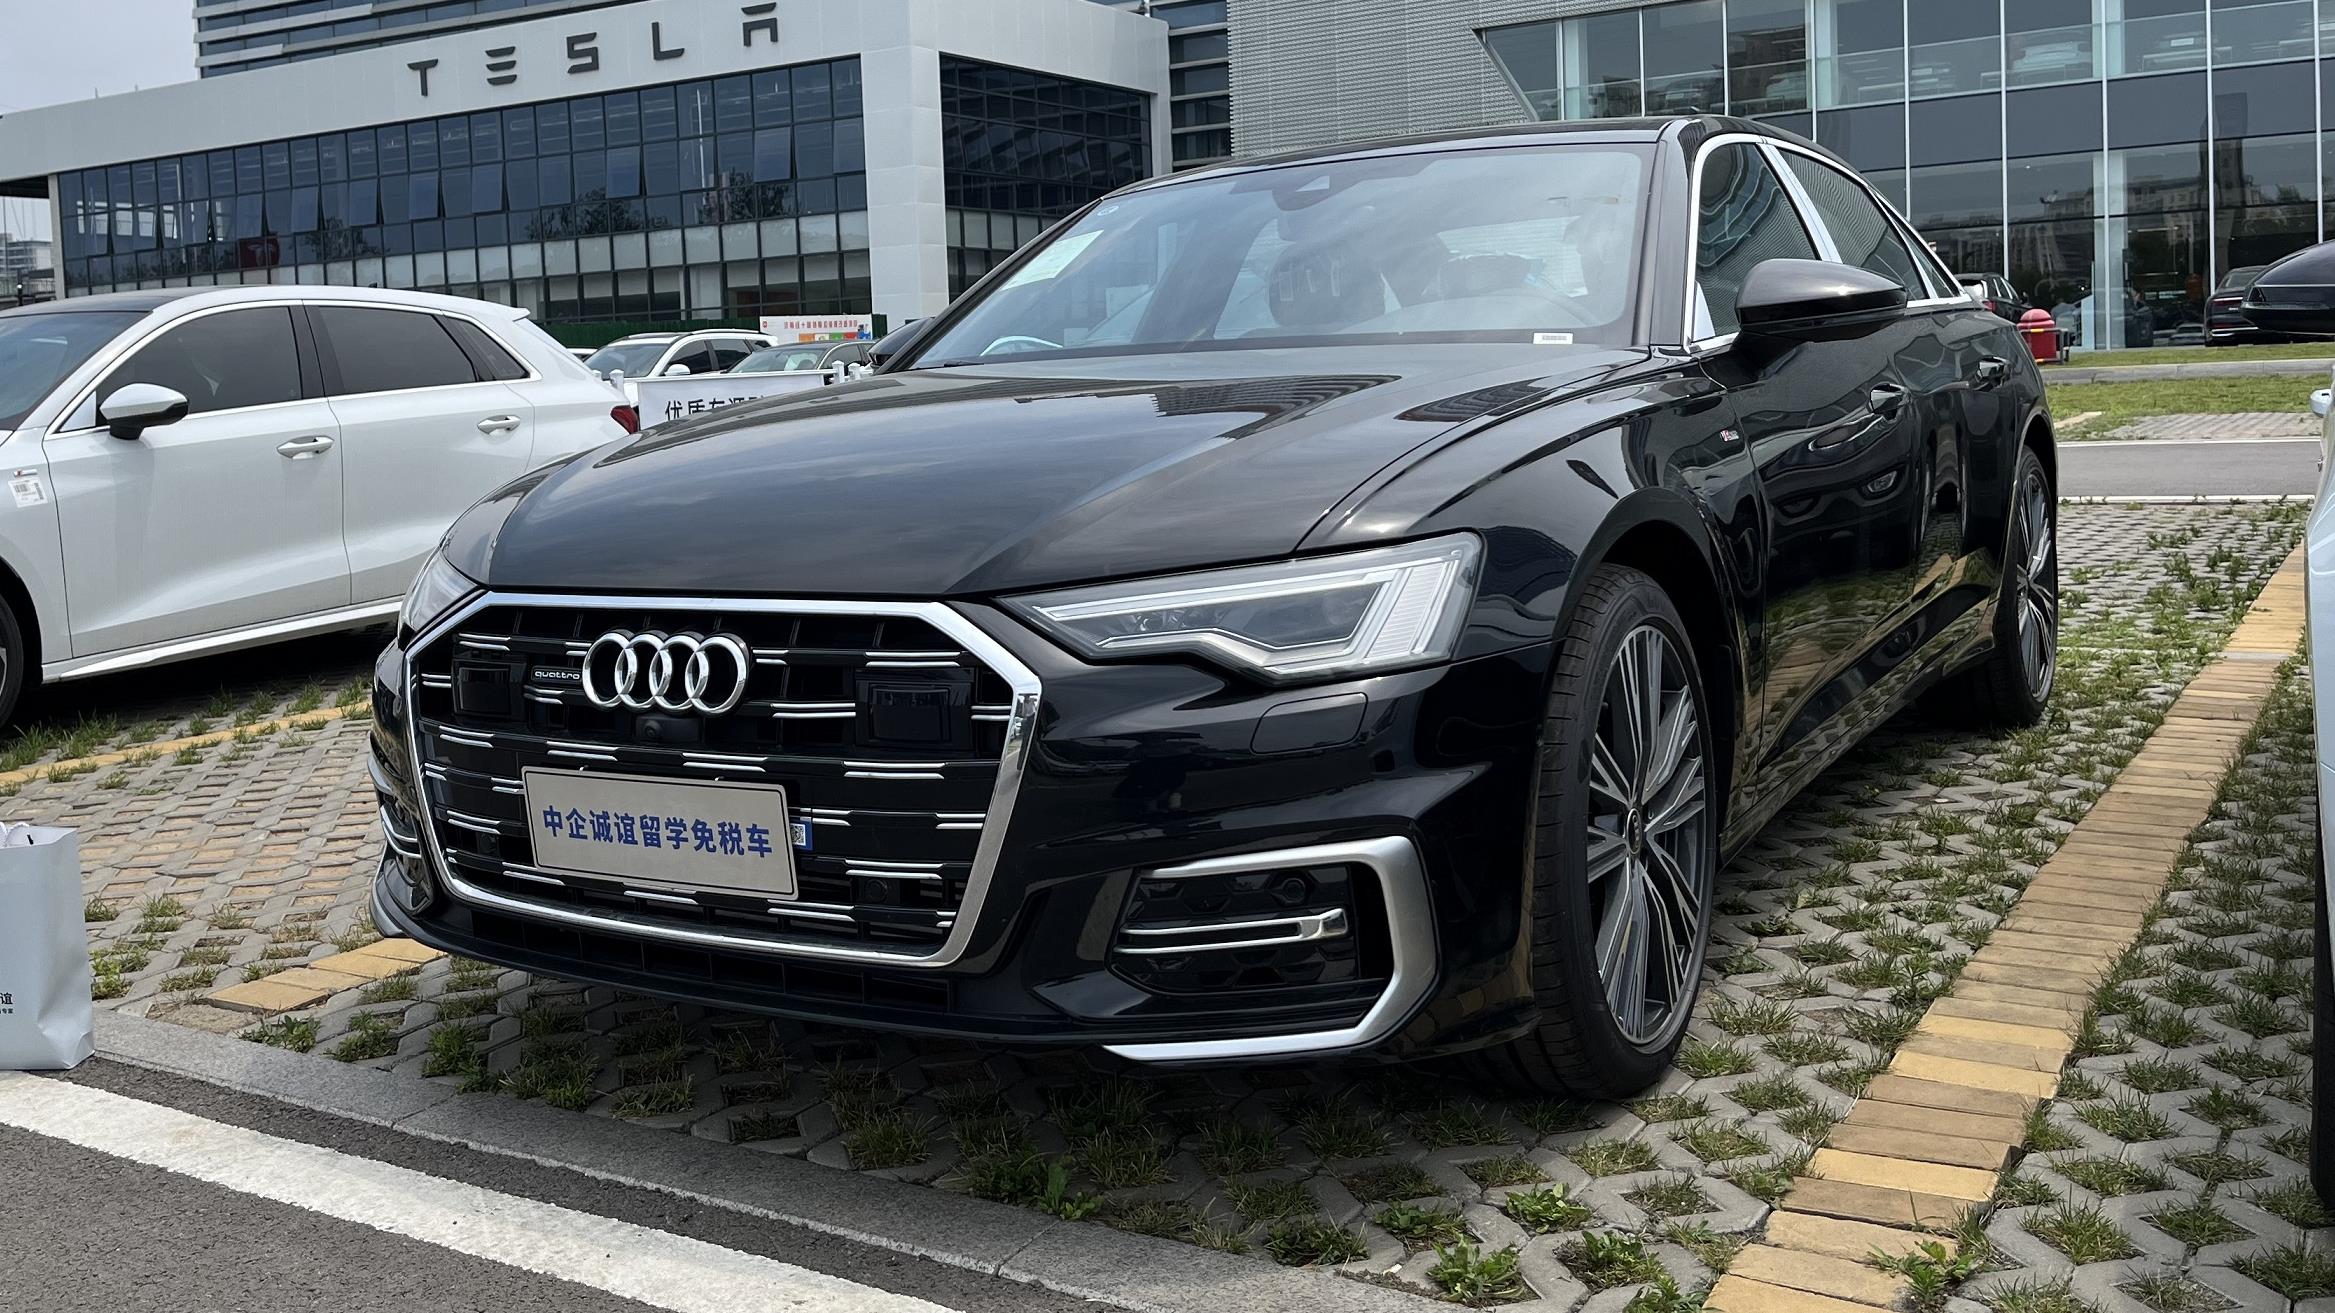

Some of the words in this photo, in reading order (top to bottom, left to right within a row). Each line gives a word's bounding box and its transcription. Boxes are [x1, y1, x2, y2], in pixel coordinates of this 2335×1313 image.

[407, 2, 778, 96] TESLA
[534, 671, 580, 680] quattro
[543, 805, 772, 857] 中企诚谊留学免税车
